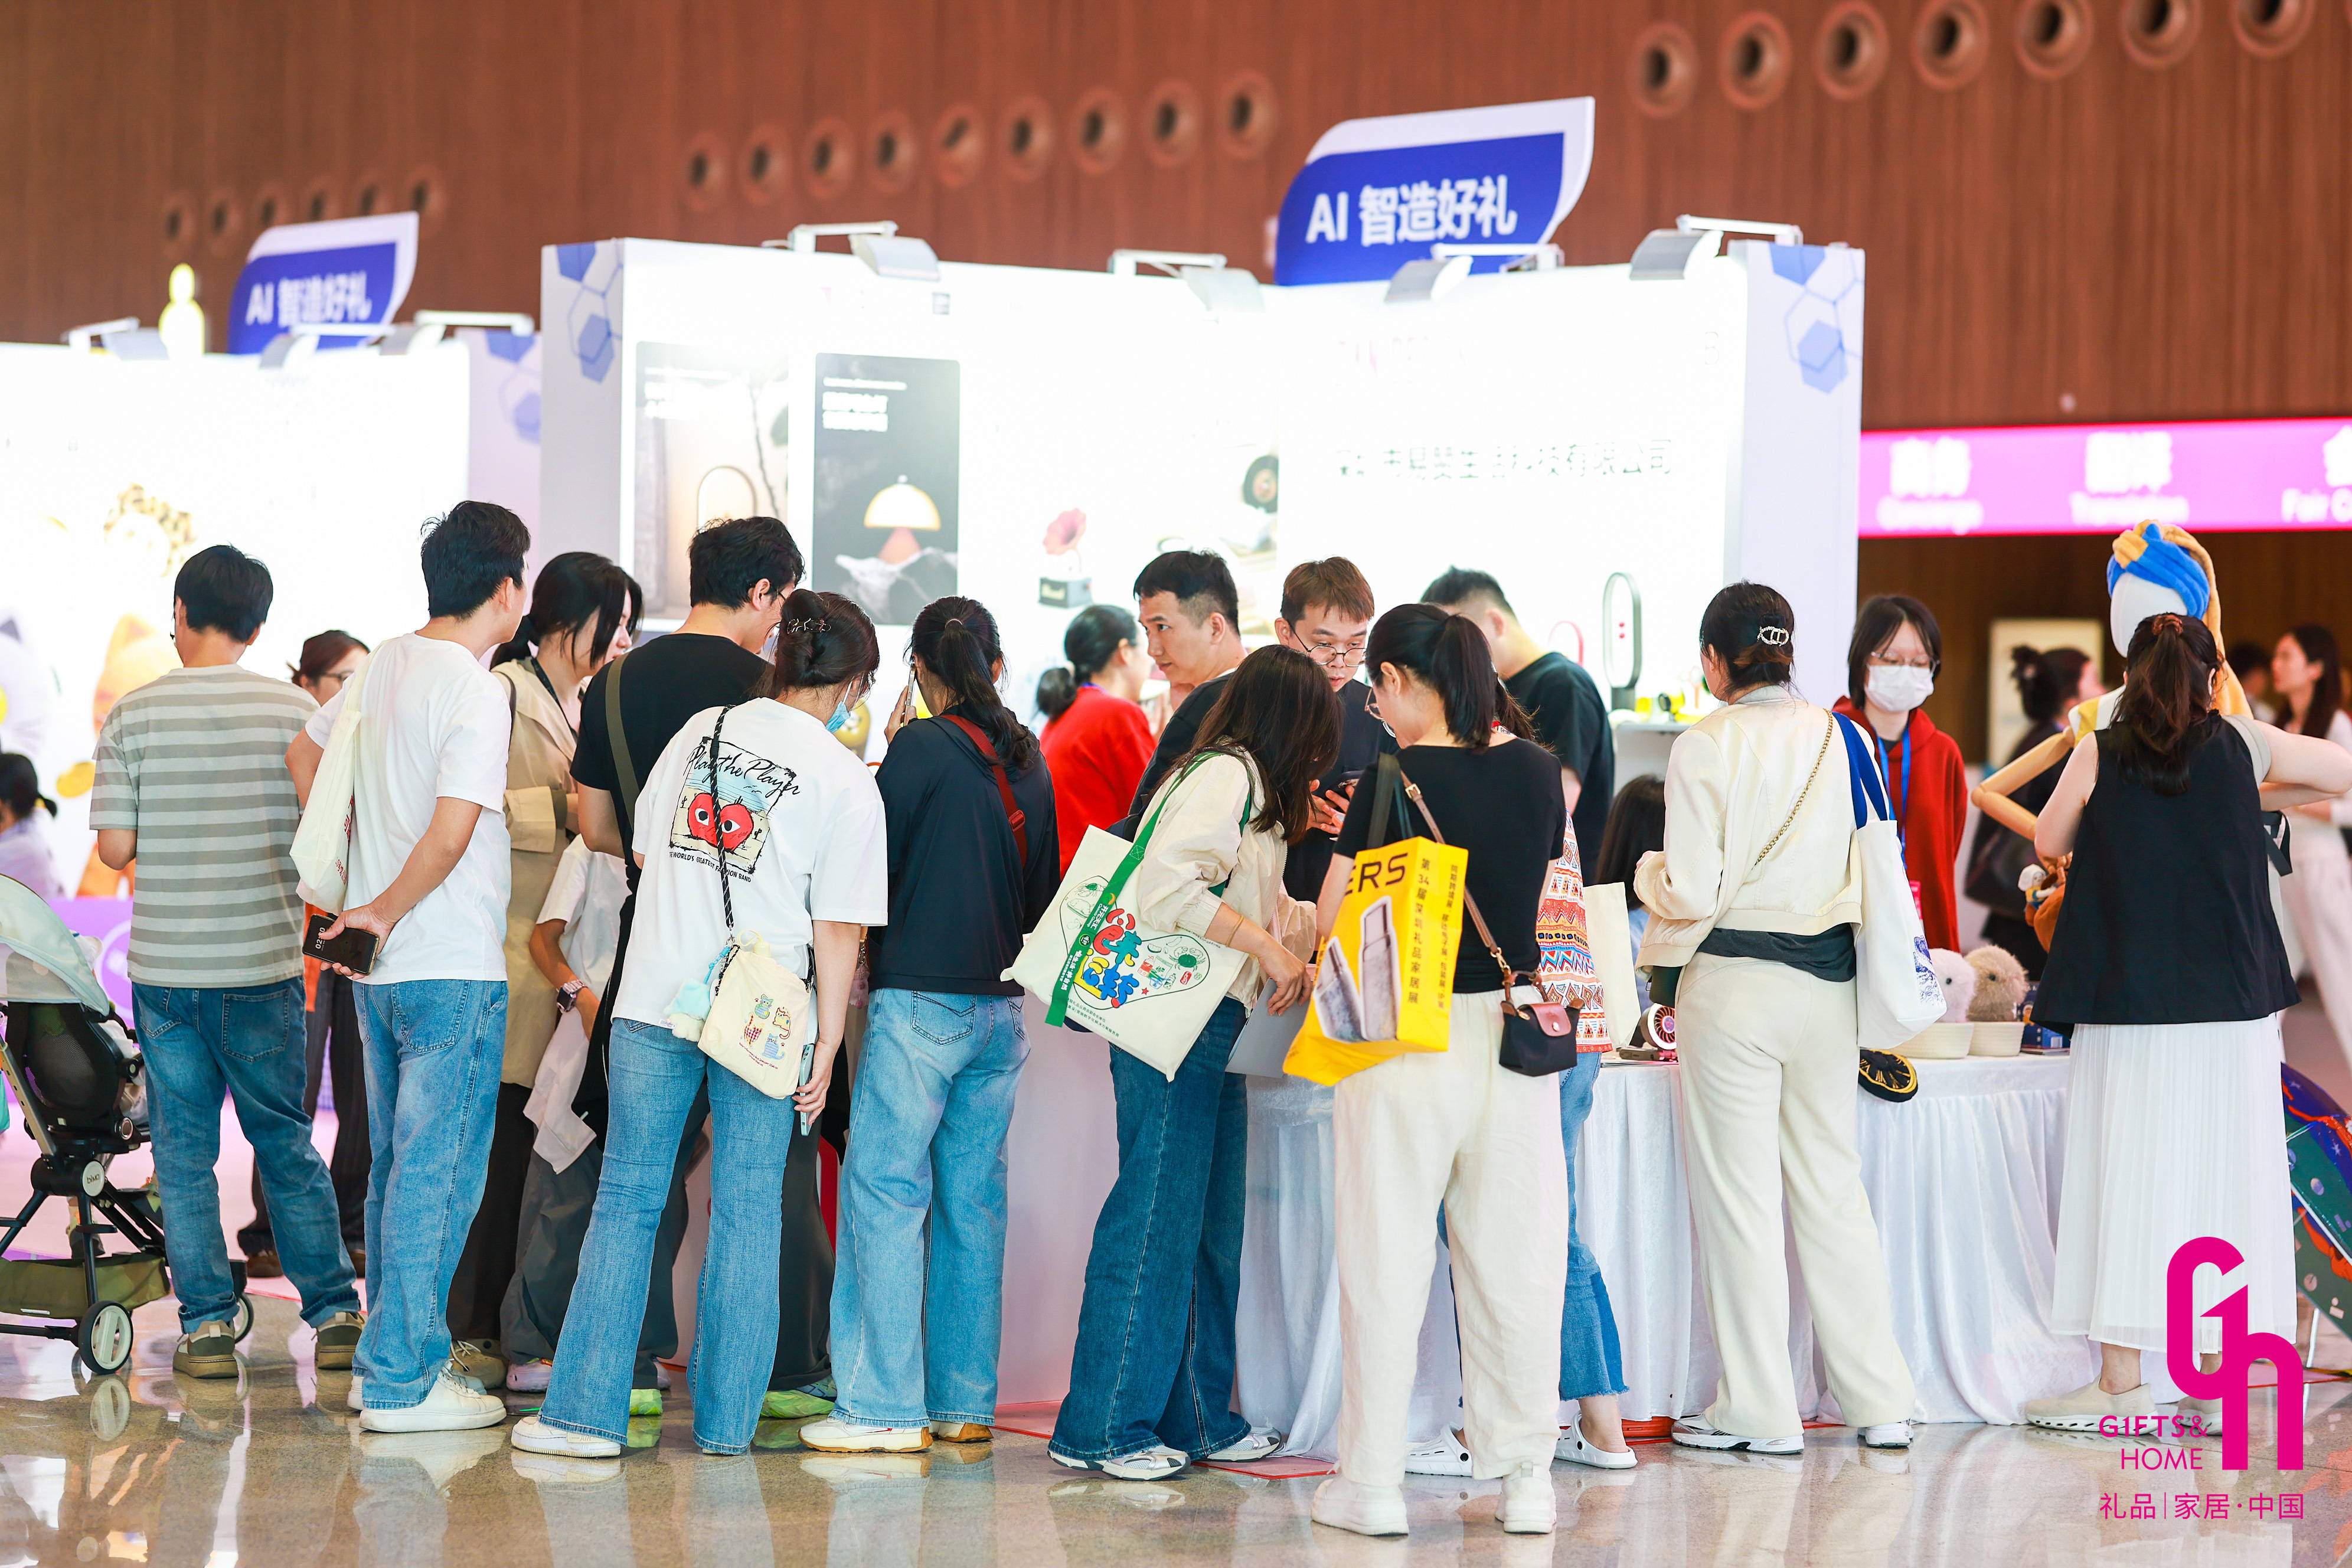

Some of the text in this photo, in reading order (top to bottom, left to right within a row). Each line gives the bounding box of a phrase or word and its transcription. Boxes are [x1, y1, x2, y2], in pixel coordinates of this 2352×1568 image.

[1305, 174, 1518, 247] AI 智造好礼
[245, 281, 275, 326] AI
[718, 753, 743, 777] the
[744, 758, 801, 798] Player
[673, 852, 694, 861] WORLD'S
[696, 857, 715, 869] GREATEST
[715, 866, 737, 878] FAION
[739, 873, 751, 883] BAND
[1090, 905, 1109, 930] 开元天汇
[315, 927, 325, 949] 02:0
